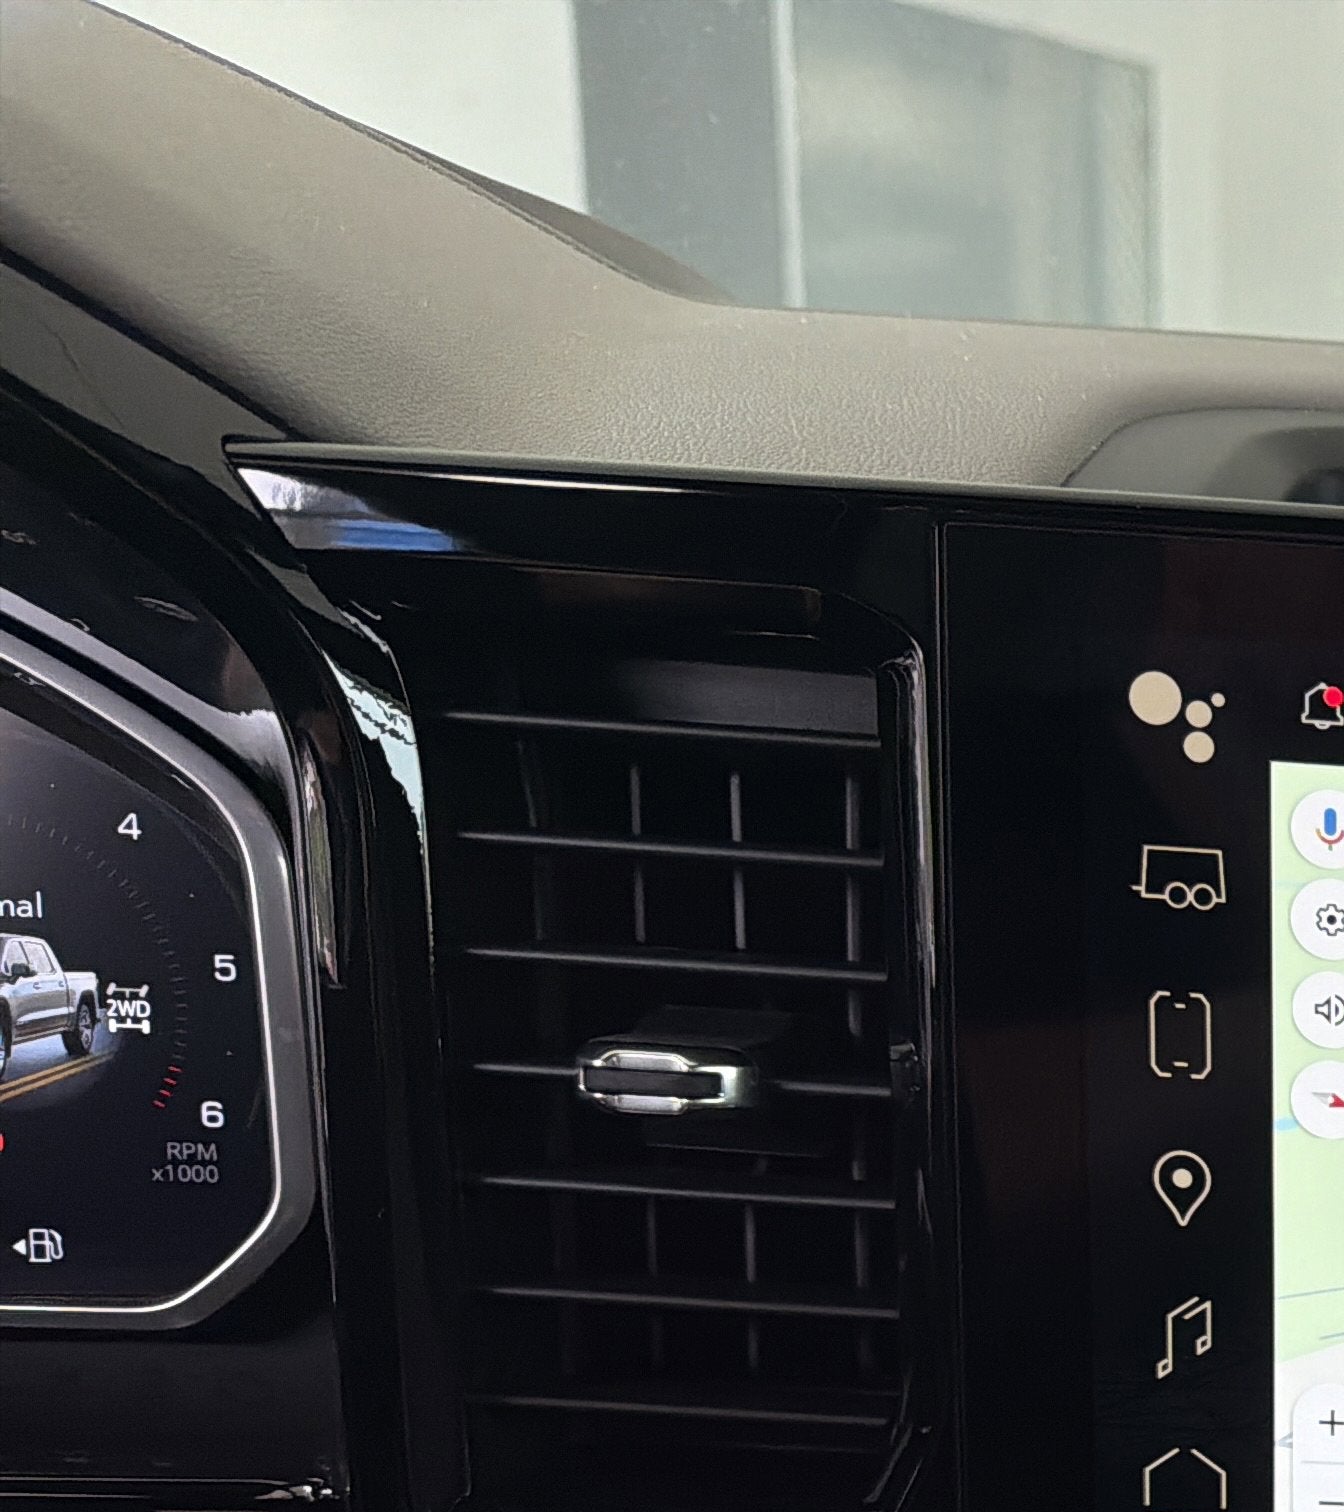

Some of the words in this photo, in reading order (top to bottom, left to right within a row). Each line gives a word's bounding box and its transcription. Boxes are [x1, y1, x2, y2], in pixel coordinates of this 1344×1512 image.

[118, 813, 142, 840] 4
[213, 955, 236, 982] 5
[107, 1000, 150, 1018] 2WD
[200, 1102, 225, 1128] 6
[167, 1142, 218, 1161] RPM
[152, 1165, 218, 1183] x1000
